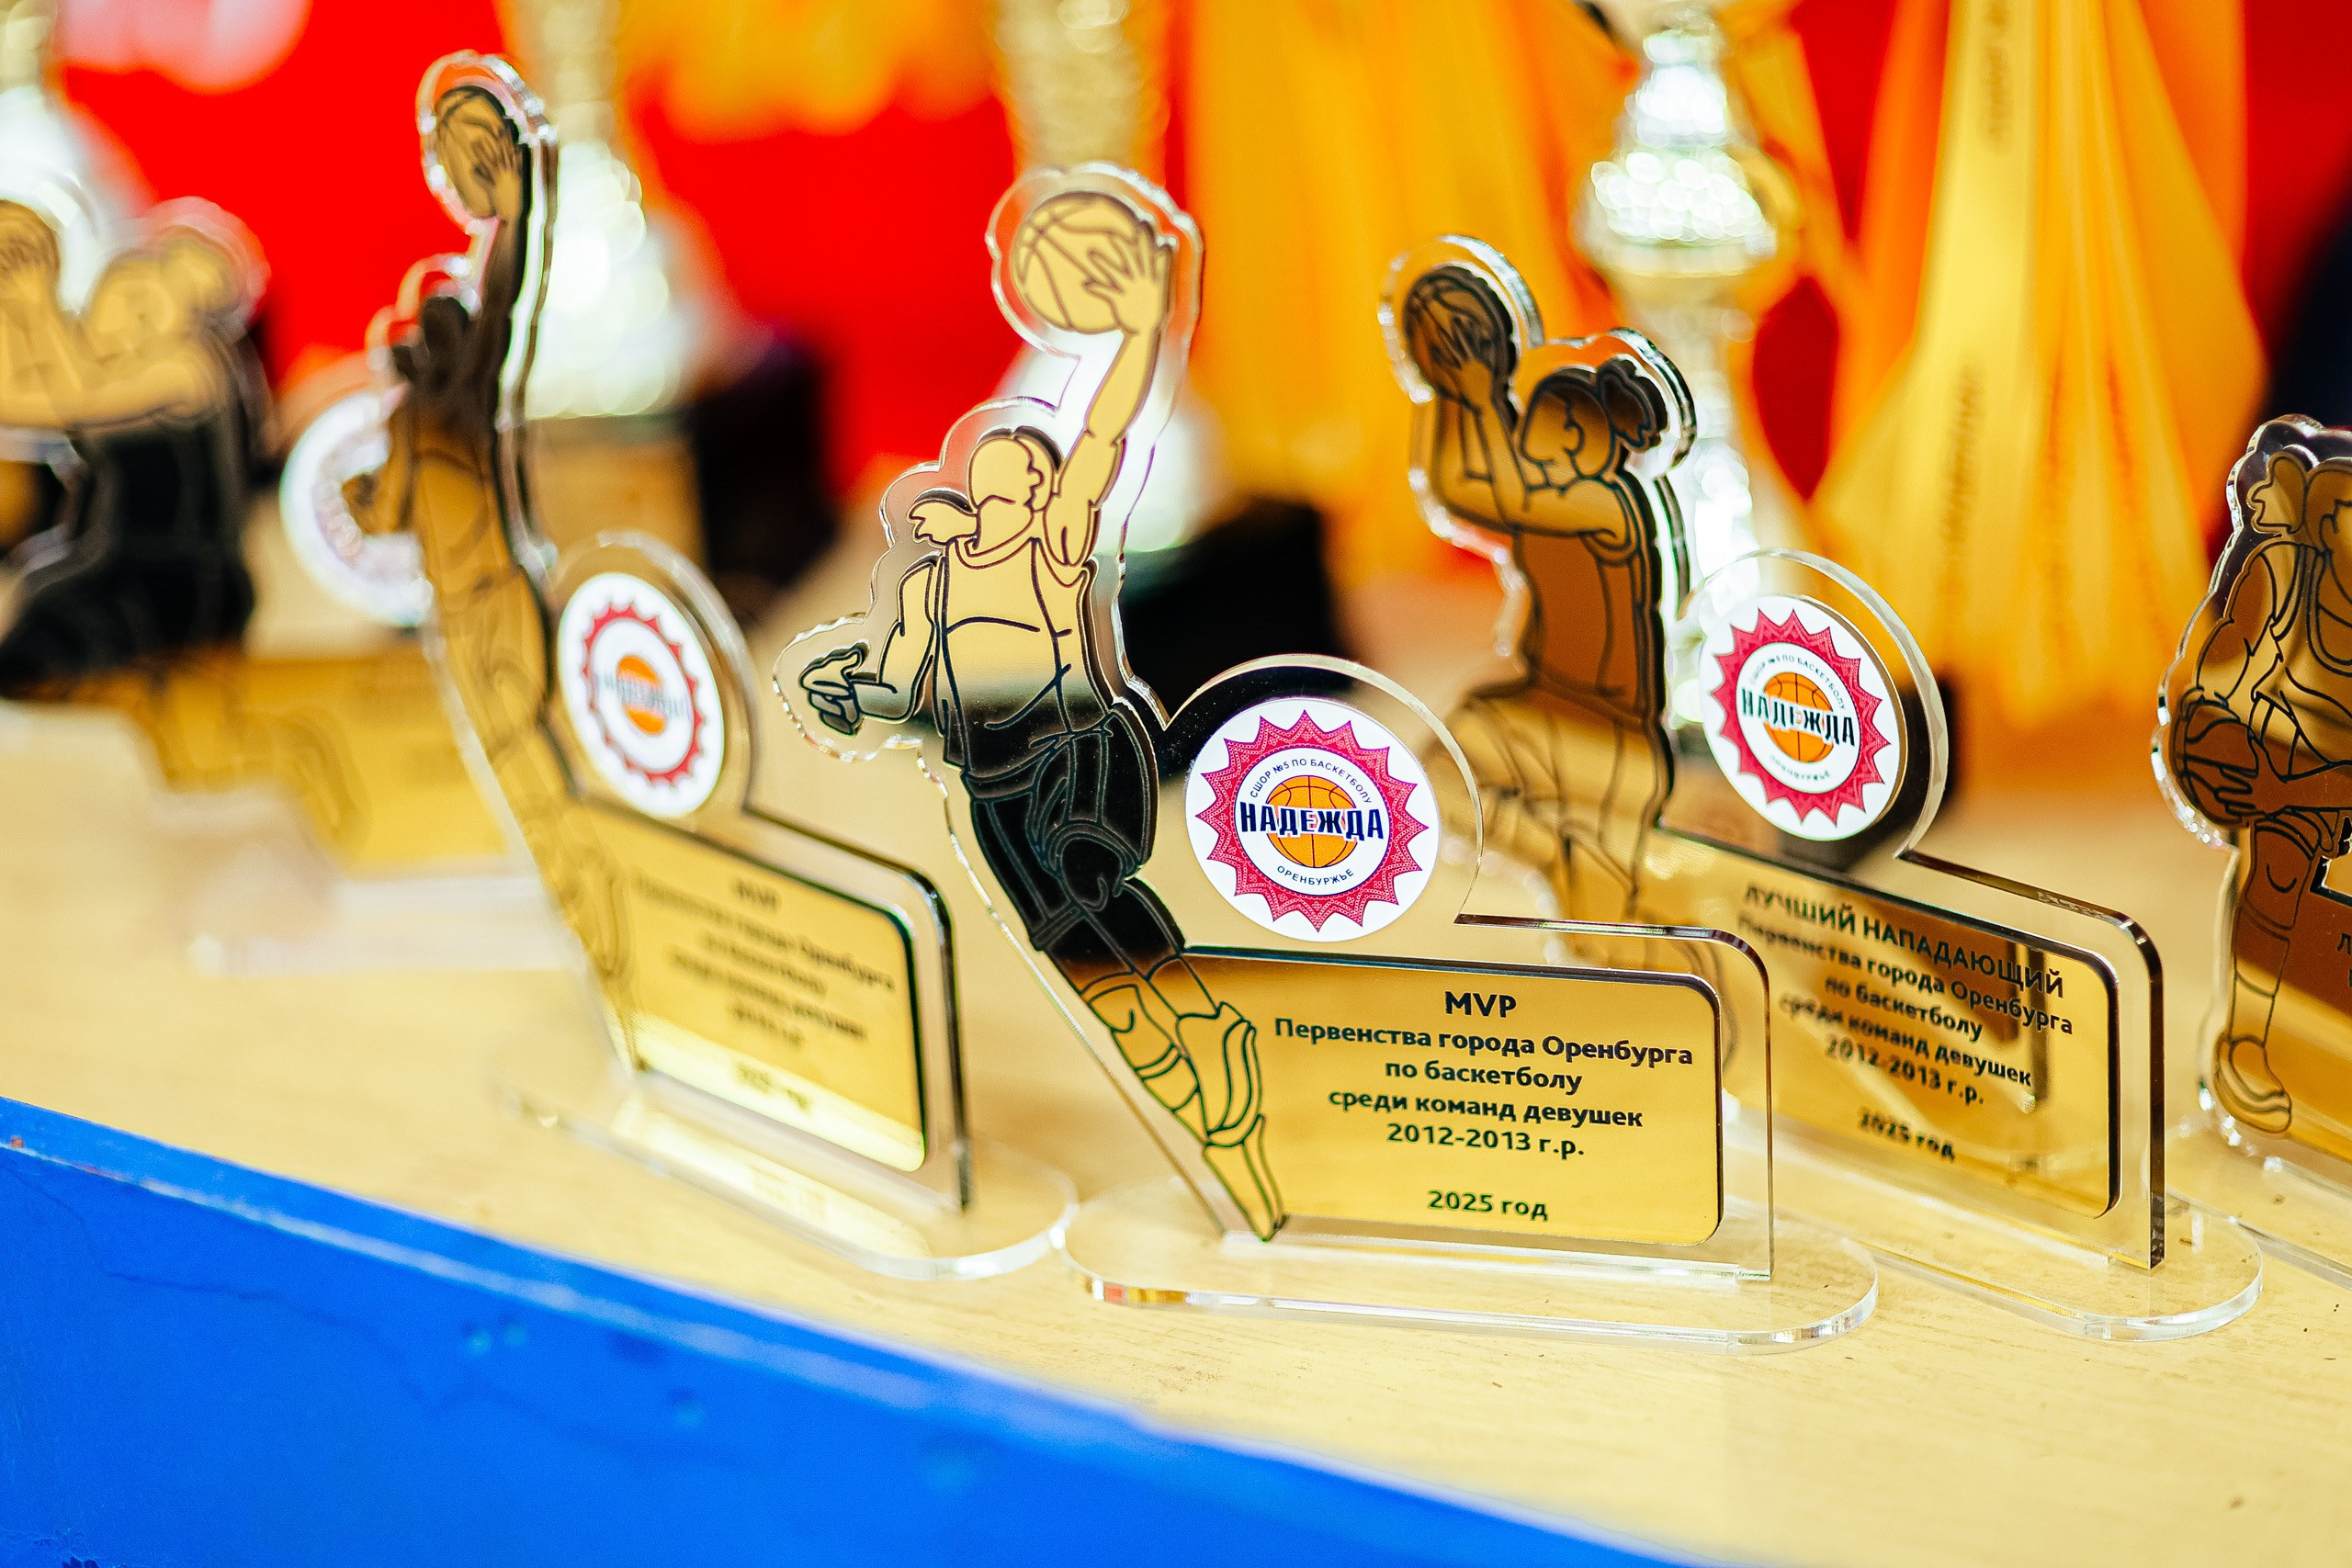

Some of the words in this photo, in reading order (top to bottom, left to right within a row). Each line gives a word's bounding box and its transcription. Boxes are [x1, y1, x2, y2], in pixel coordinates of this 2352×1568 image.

[1250, 771, 1272, 798] СШОР
[1272, 761, 1290, 774] №5
[1292, 758, 1307, 767] ПО
[1310, 759, 1373, 804] БАСКЕТБОЛУ
[1240, 801, 1385, 841] НАДЕЖДА
[1277, 865, 1354, 886] ОРЕНБУРЖЬЕ
[1863, 916, 2064, 998] НАПАДАЮЩИЙ
[1445, 990, 1517, 1019] MVP
[1856, 982, 1984, 1043] баскетболу
[1867, 956, 1945, 994] города
[1951, 983, 2074, 1035] Оренбурга
[1274, 1018, 1432, 1047] Первенства
[1439, 1033, 1535, 1056] города
[1542, 1035, 1693, 1067] Оренбурга
[1385, 1061, 1418, 1079] по
[1424, 1060, 1583, 1095] баскетболу
[1936, 1043, 2032, 1088] девушек
[1329, 1089, 1408, 1113] среди
[1416, 1097, 1517, 1122] команд
[1523, 1105, 1644, 1129] девушек
[1386, 1122, 1531, 1152] 2012-2013
[1539, 1137, 1585, 1161] г.р.
[1428, 1190, 1494, 1213] 2025
[1502, 1200, 1549, 1222] год
